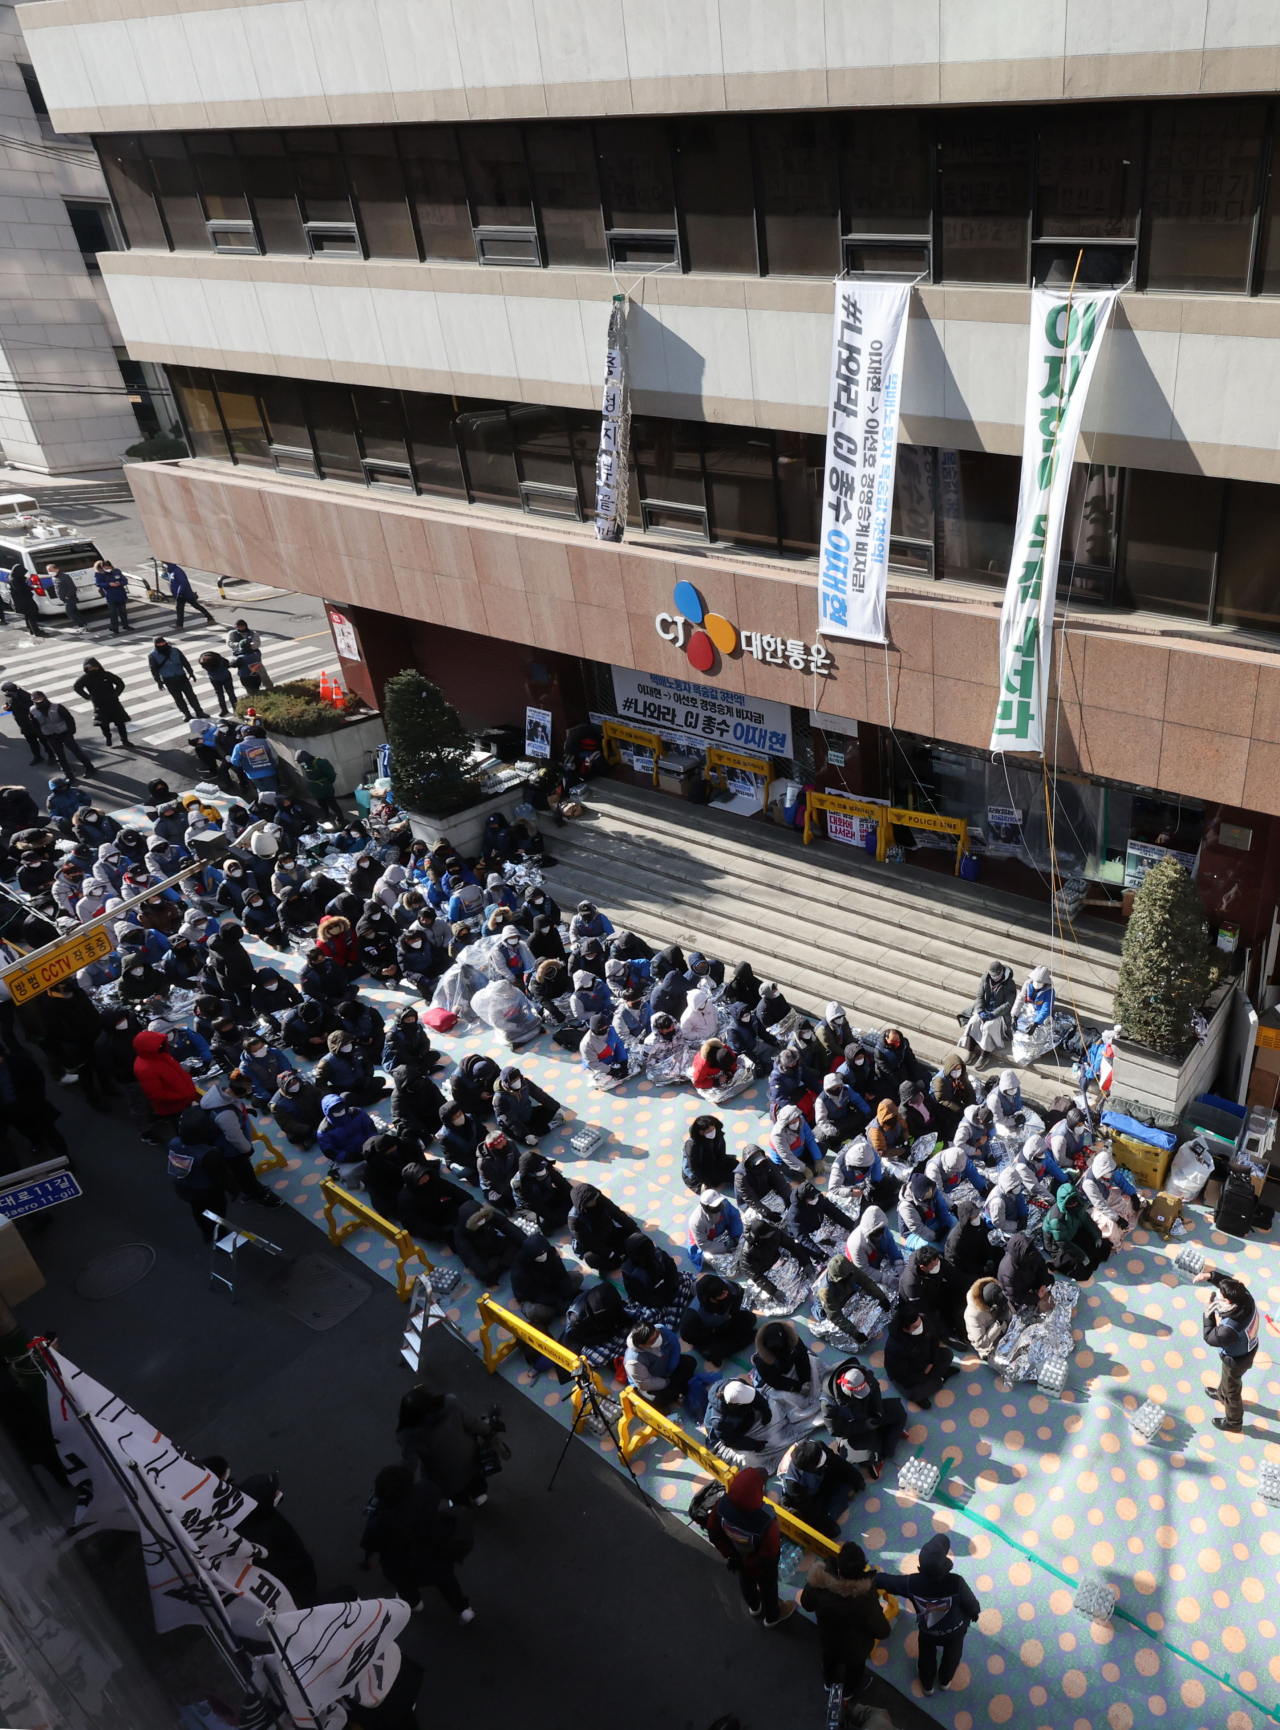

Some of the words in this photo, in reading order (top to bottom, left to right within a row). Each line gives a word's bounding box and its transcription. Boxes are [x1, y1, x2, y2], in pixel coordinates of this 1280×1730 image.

[866, 339, 883, 392] 이재현
[862, 418, 880, 469] 이선호
[827, 469, 854, 526] 총수
[856, 473, 876, 537] 경영승계
[876, 463, 892, 514] 목숨값
[870, 516, 887, 565] 3천억!
[822, 528, 851, 627] 이재현
[851, 536, 869, 593] 비자금!
[655, 612, 685, 648] CJ
[741, 630, 832, 675] 대한통운
[637, 683, 662, 700] 이재현
[673, 692, 699, 709] 이선호
[699, 701, 735, 718] 경영승계
[735, 708, 765, 725] 비자금!
[693, 684, 719, 699] 목숨값
[719, 689, 746, 706] 3천억!
[622, 697, 699, 729] #나와라_CJ
[701, 715, 731, 738] 총수
[733, 722, 787, 754] 이재현
[829, 815, 854, 830] 대화에
[830, 825, 856, 841] 나서라!
[908, 815, 938, 827] POLICE
[940, 821, 957, 831] LINE
[41, 955, 72, 983] CCTV
[72, 936, 107, 962] 작동중
[14, 972, 40, 997] 방범
[40, 1187, 76, 1205] 11-gil
